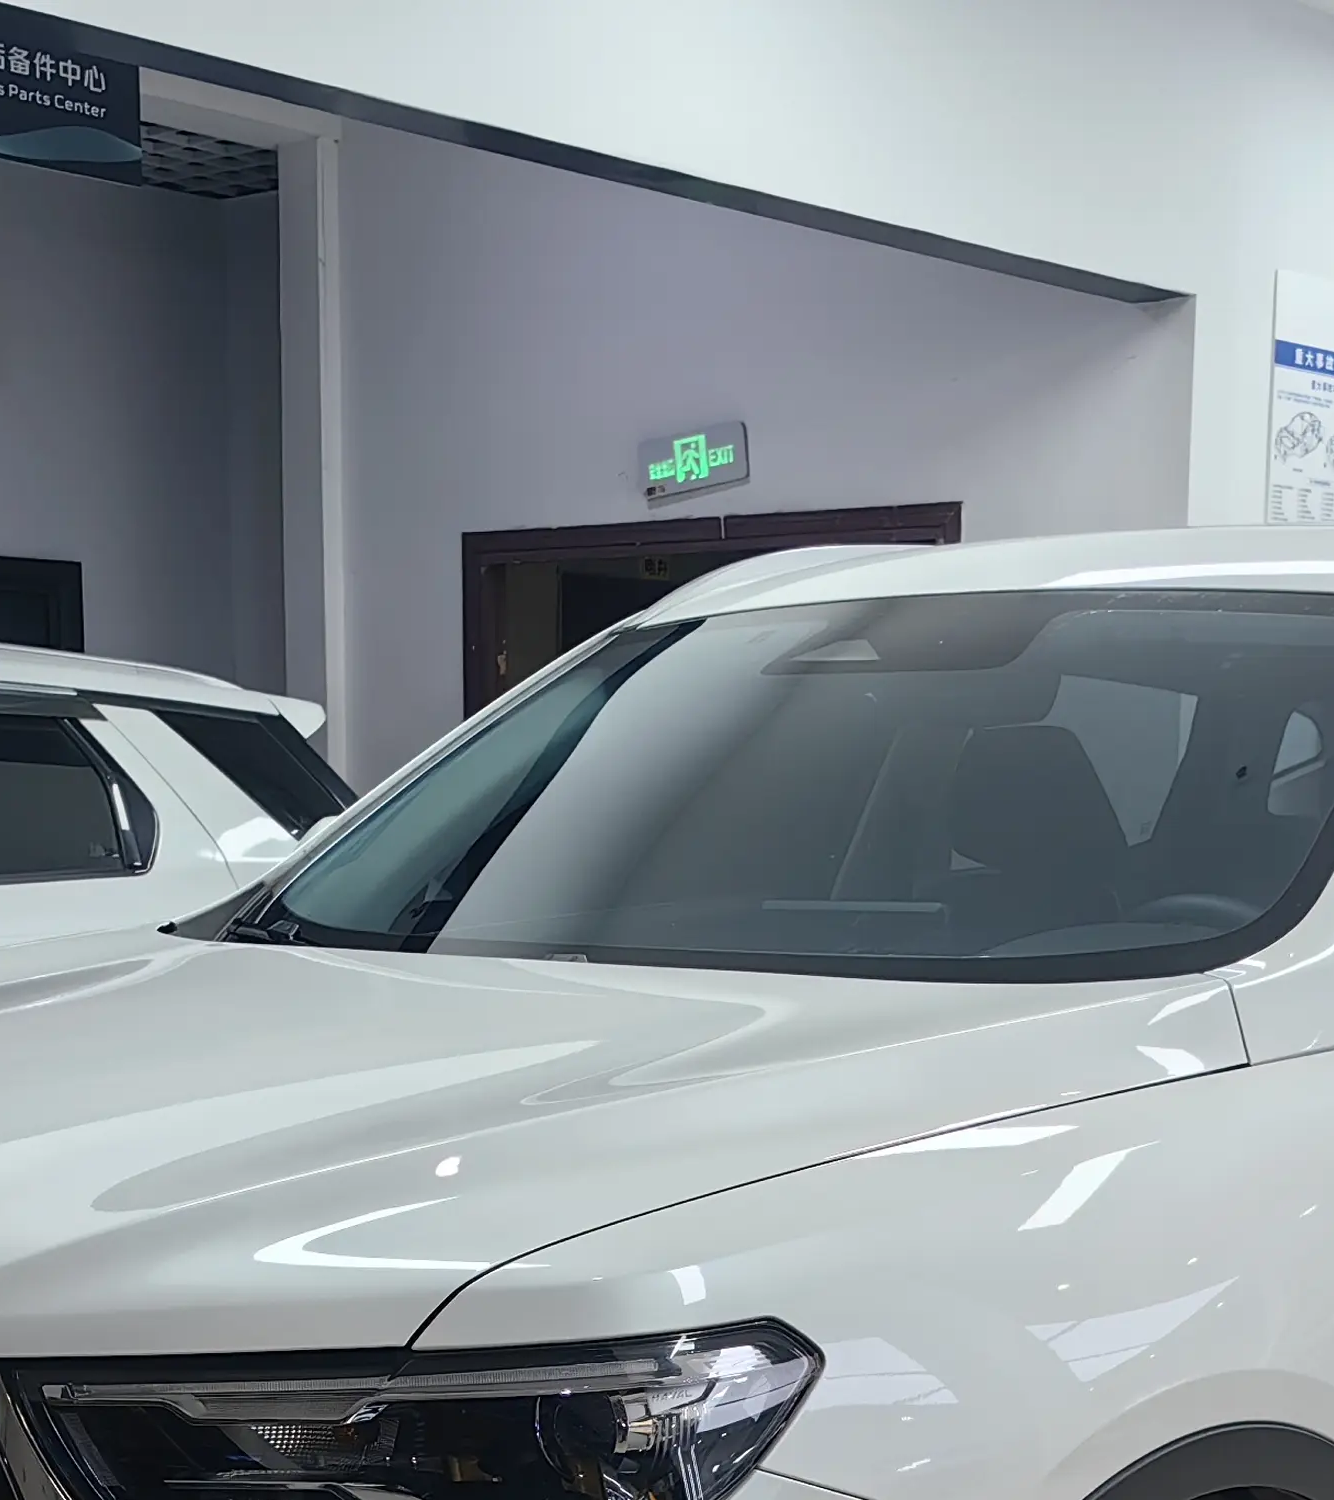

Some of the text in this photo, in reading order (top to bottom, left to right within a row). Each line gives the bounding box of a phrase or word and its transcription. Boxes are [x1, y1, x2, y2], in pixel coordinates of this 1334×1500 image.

[8, 84, 51, 107] Parts
[54, 95, 107, 120] Center
[708, 444, 734, 468] EXIT
[651, 1388, 693, 1402] HAVAL
